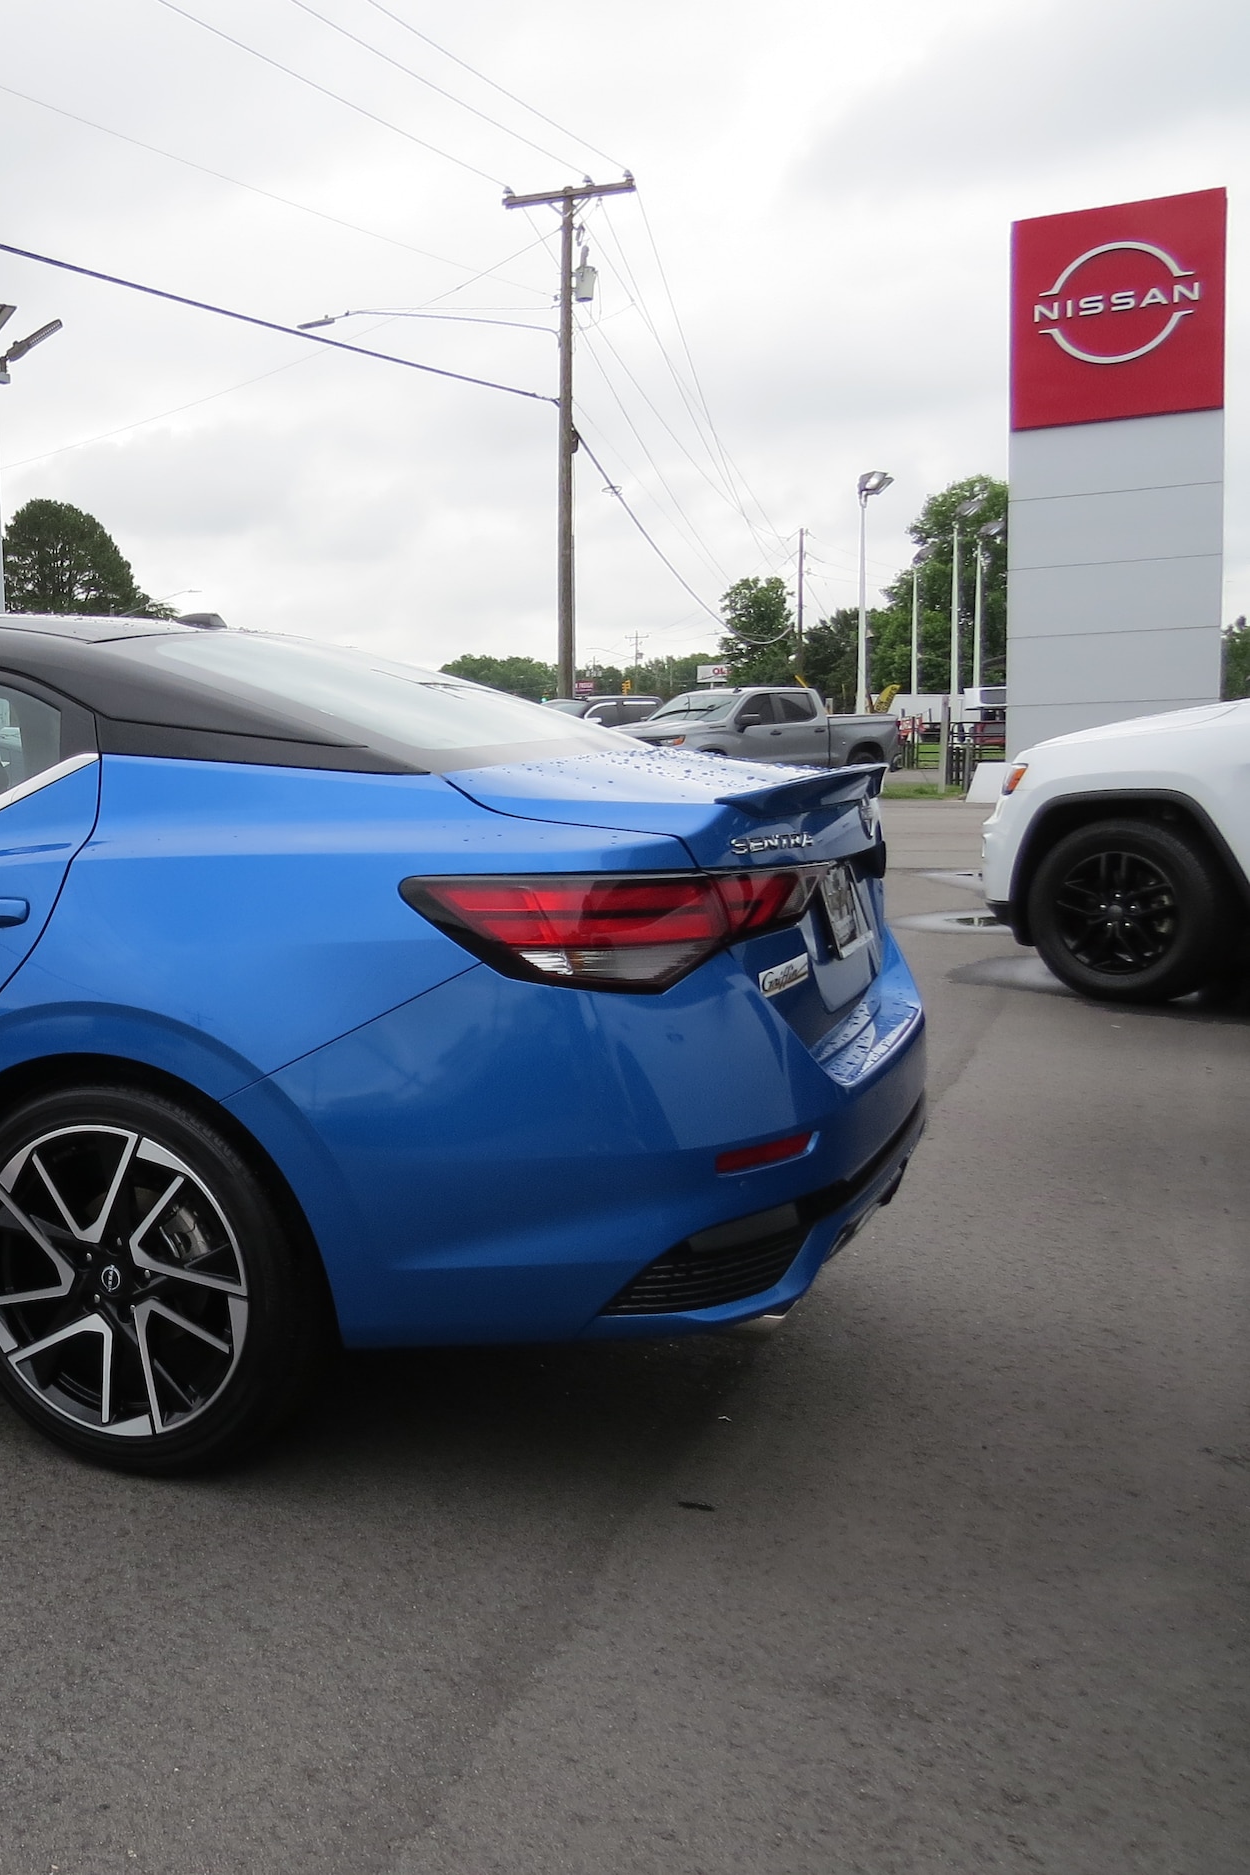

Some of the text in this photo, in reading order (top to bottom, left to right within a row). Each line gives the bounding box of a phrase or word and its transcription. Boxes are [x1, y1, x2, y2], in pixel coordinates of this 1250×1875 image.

[1033, 282, 1200, 323] NISSAN
[730, 831, 814, 855] SENTRA
[762, 964, 807, 991] Griffin
